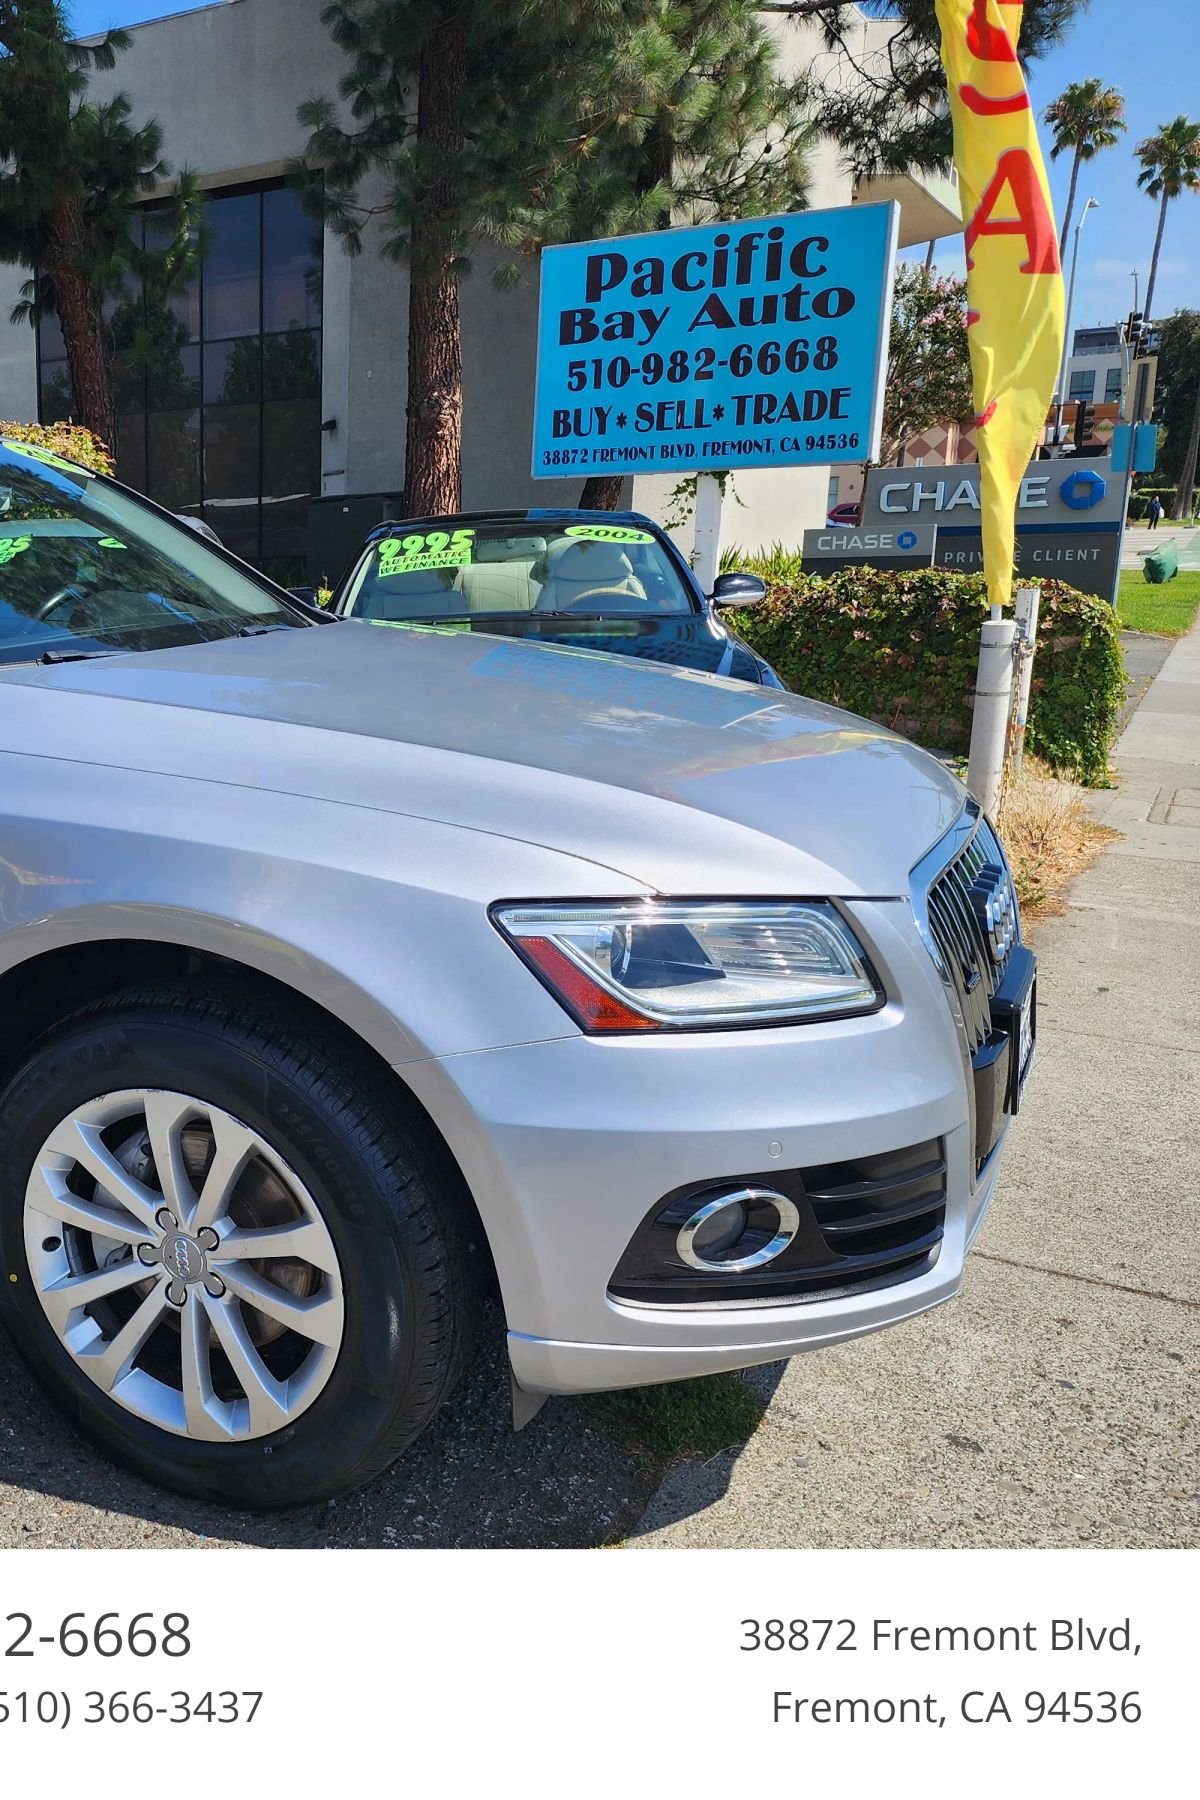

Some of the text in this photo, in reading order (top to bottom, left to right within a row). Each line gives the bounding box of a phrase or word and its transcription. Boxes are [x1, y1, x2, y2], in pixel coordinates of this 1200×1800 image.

[585, 226, 829, 304] Pacific
[559, 282, 856, 346] Bay Auto
[567, 335, 839, 392] 510-982-6668
[552, 387, 852, 438] BUY SELL TRADE
[542, 432, 860, 466] 38872 FREMONT BLVD, FREMONT, CA 94536
[879, 476, 1051, 513] CHAE
[378, 529, 476, 561] 9995
[577, 526, 647, 543] 2004
[817, 534, 894, 551] CHASE
[380, 558, 469, 575] WE FINANCE
[381, 550, 468, 567] AUTOMATIC
[944, 548, 1101, 564] PRIE CLIENT
